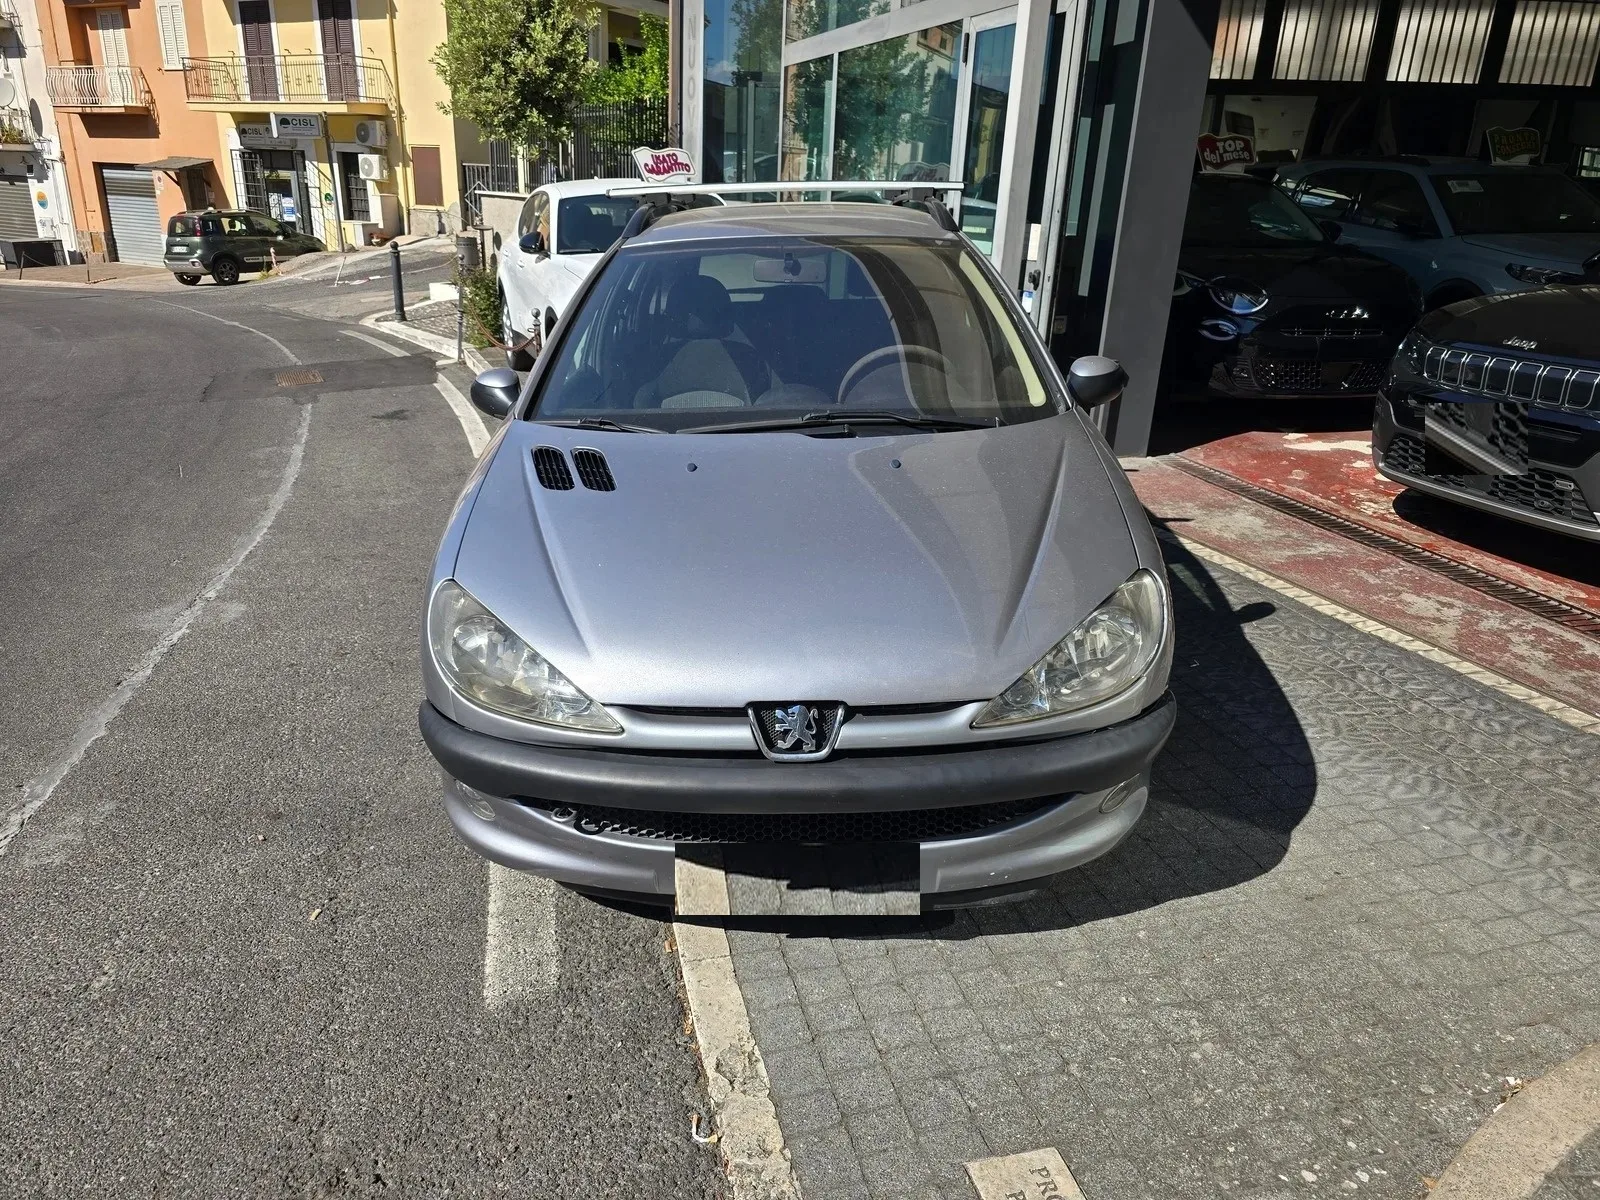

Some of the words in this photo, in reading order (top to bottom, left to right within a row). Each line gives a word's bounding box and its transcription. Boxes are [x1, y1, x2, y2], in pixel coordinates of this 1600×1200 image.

[291, 118, 315, 127] CISL
[1216, 140, 1244, 153] TOP
[651, 153, 678, 166] USATO
[1204, 148, 1220, 163] del
[1223, 151, 1250, 161] mese
[644, 162, 691, 175] GARANTITO
[1503, 336, 1538, 350] Jeep
